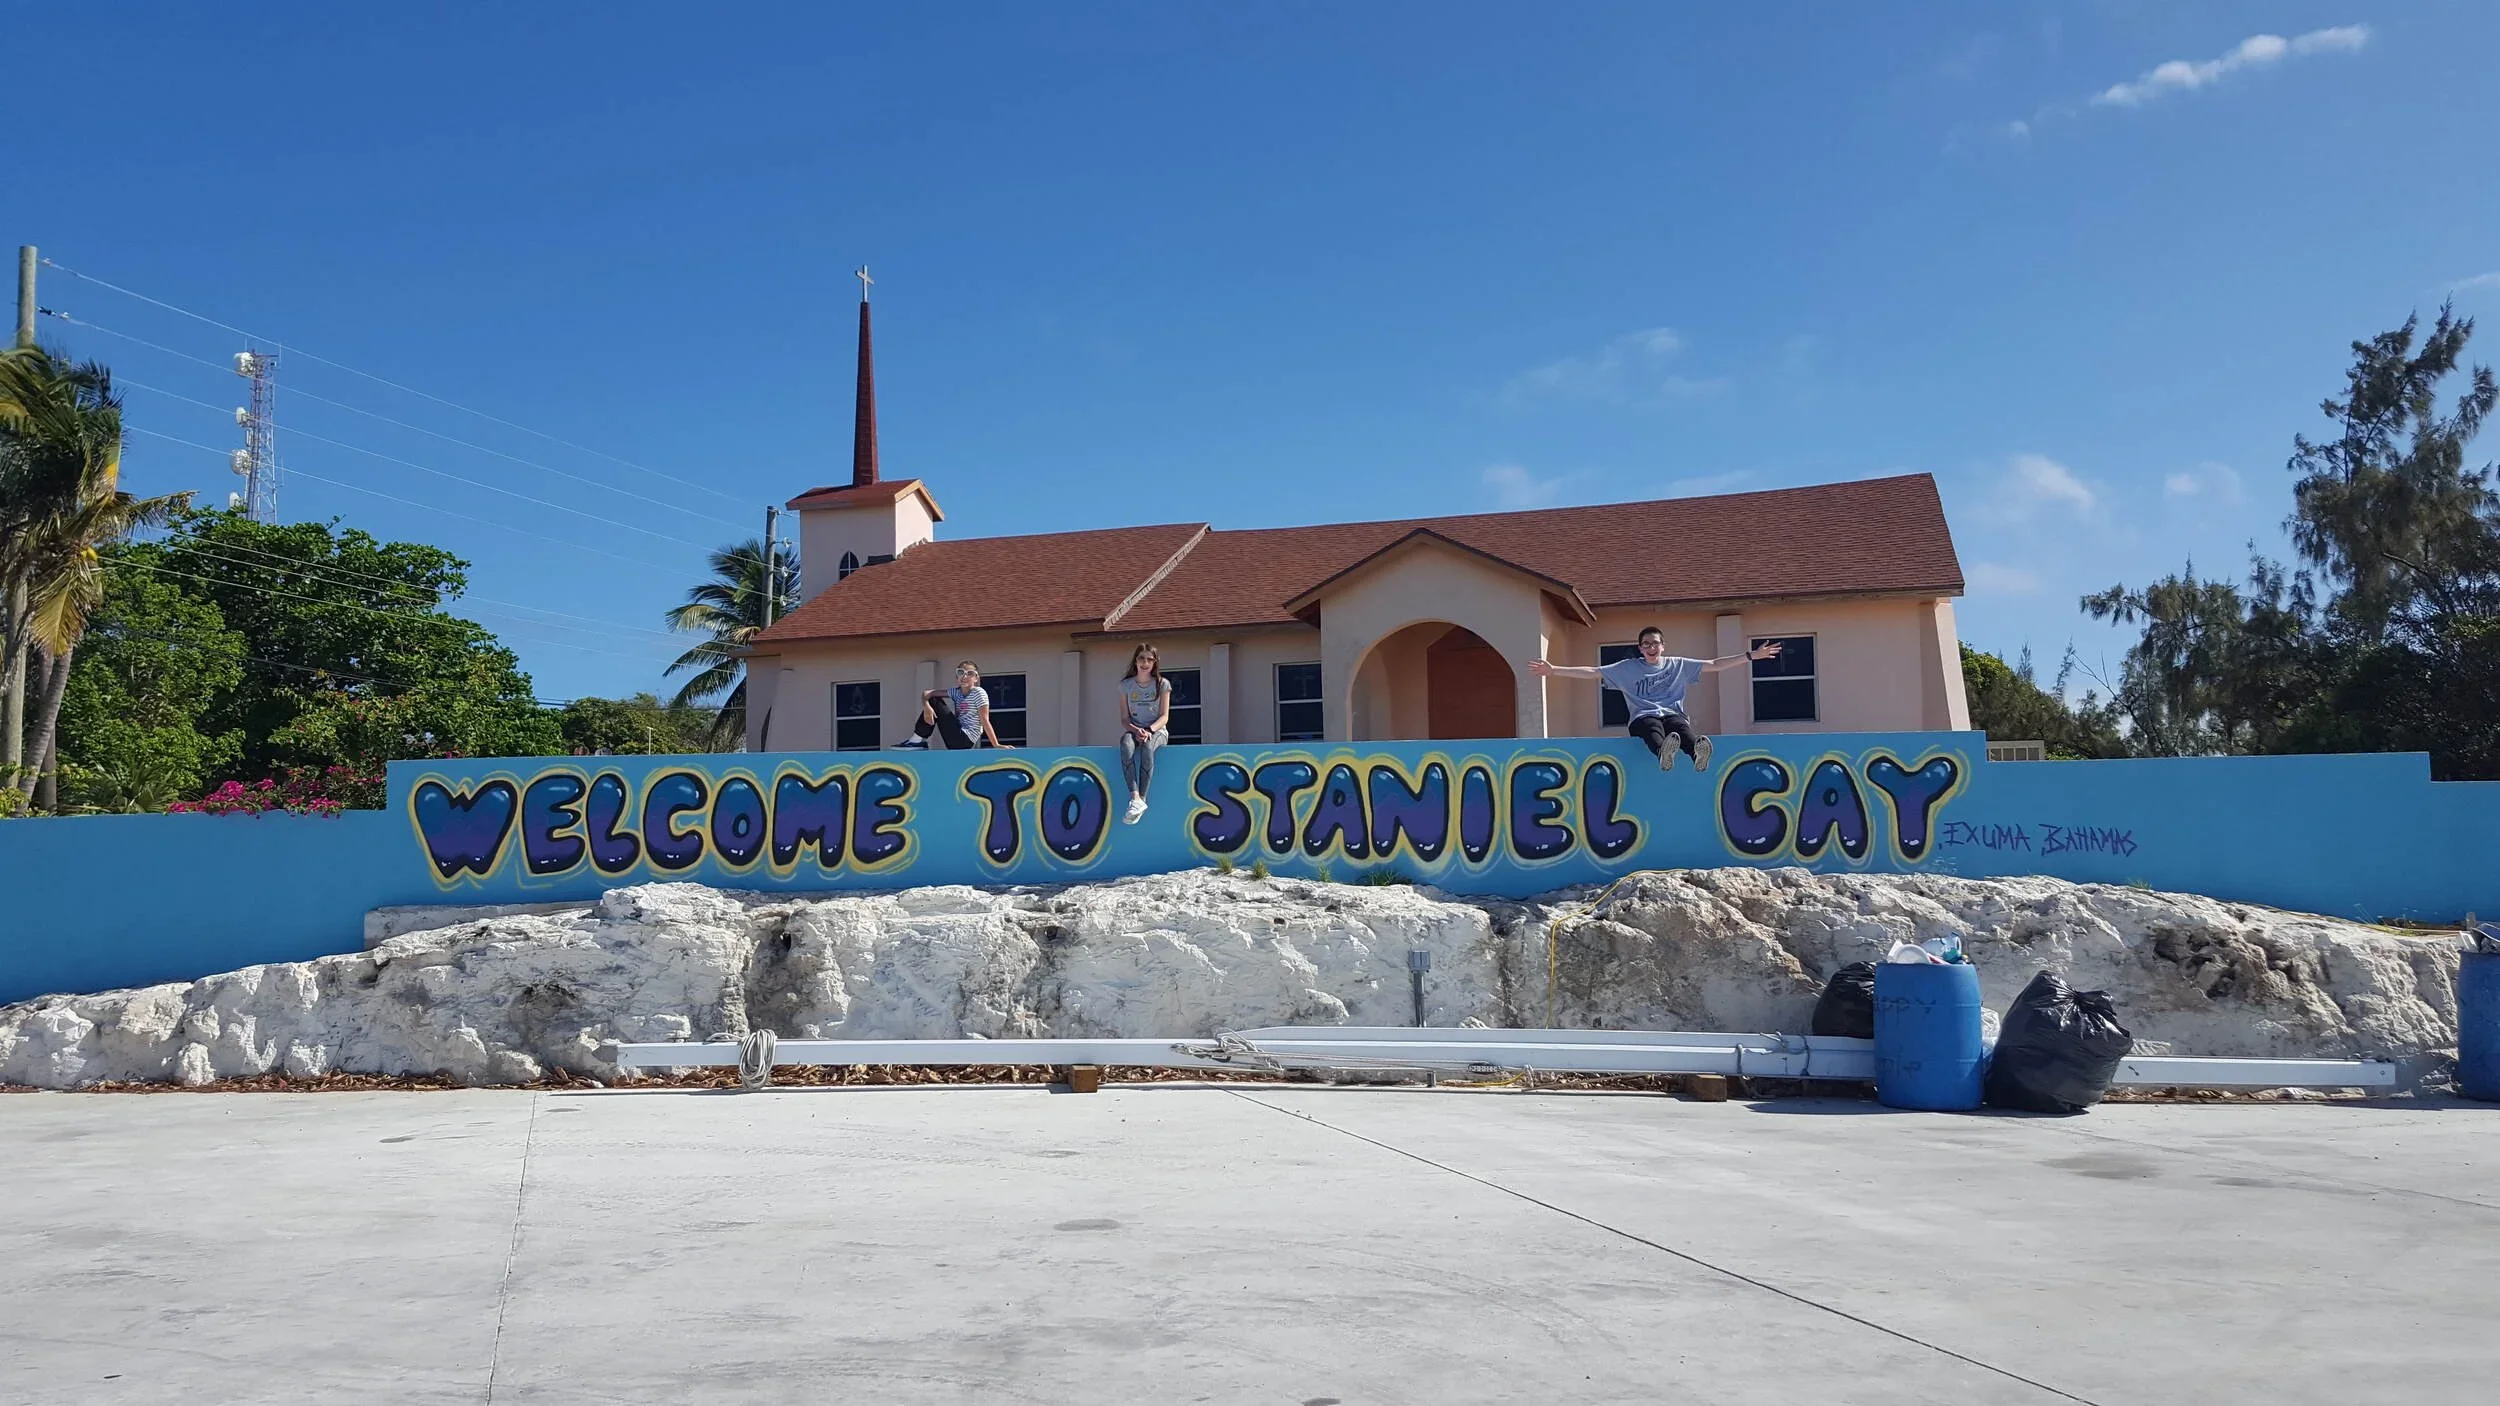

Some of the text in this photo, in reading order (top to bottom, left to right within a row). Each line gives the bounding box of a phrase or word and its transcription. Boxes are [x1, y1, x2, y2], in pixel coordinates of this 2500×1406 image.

[414, 755, 1959, 876] WELCOME TO STANIEL CAY
